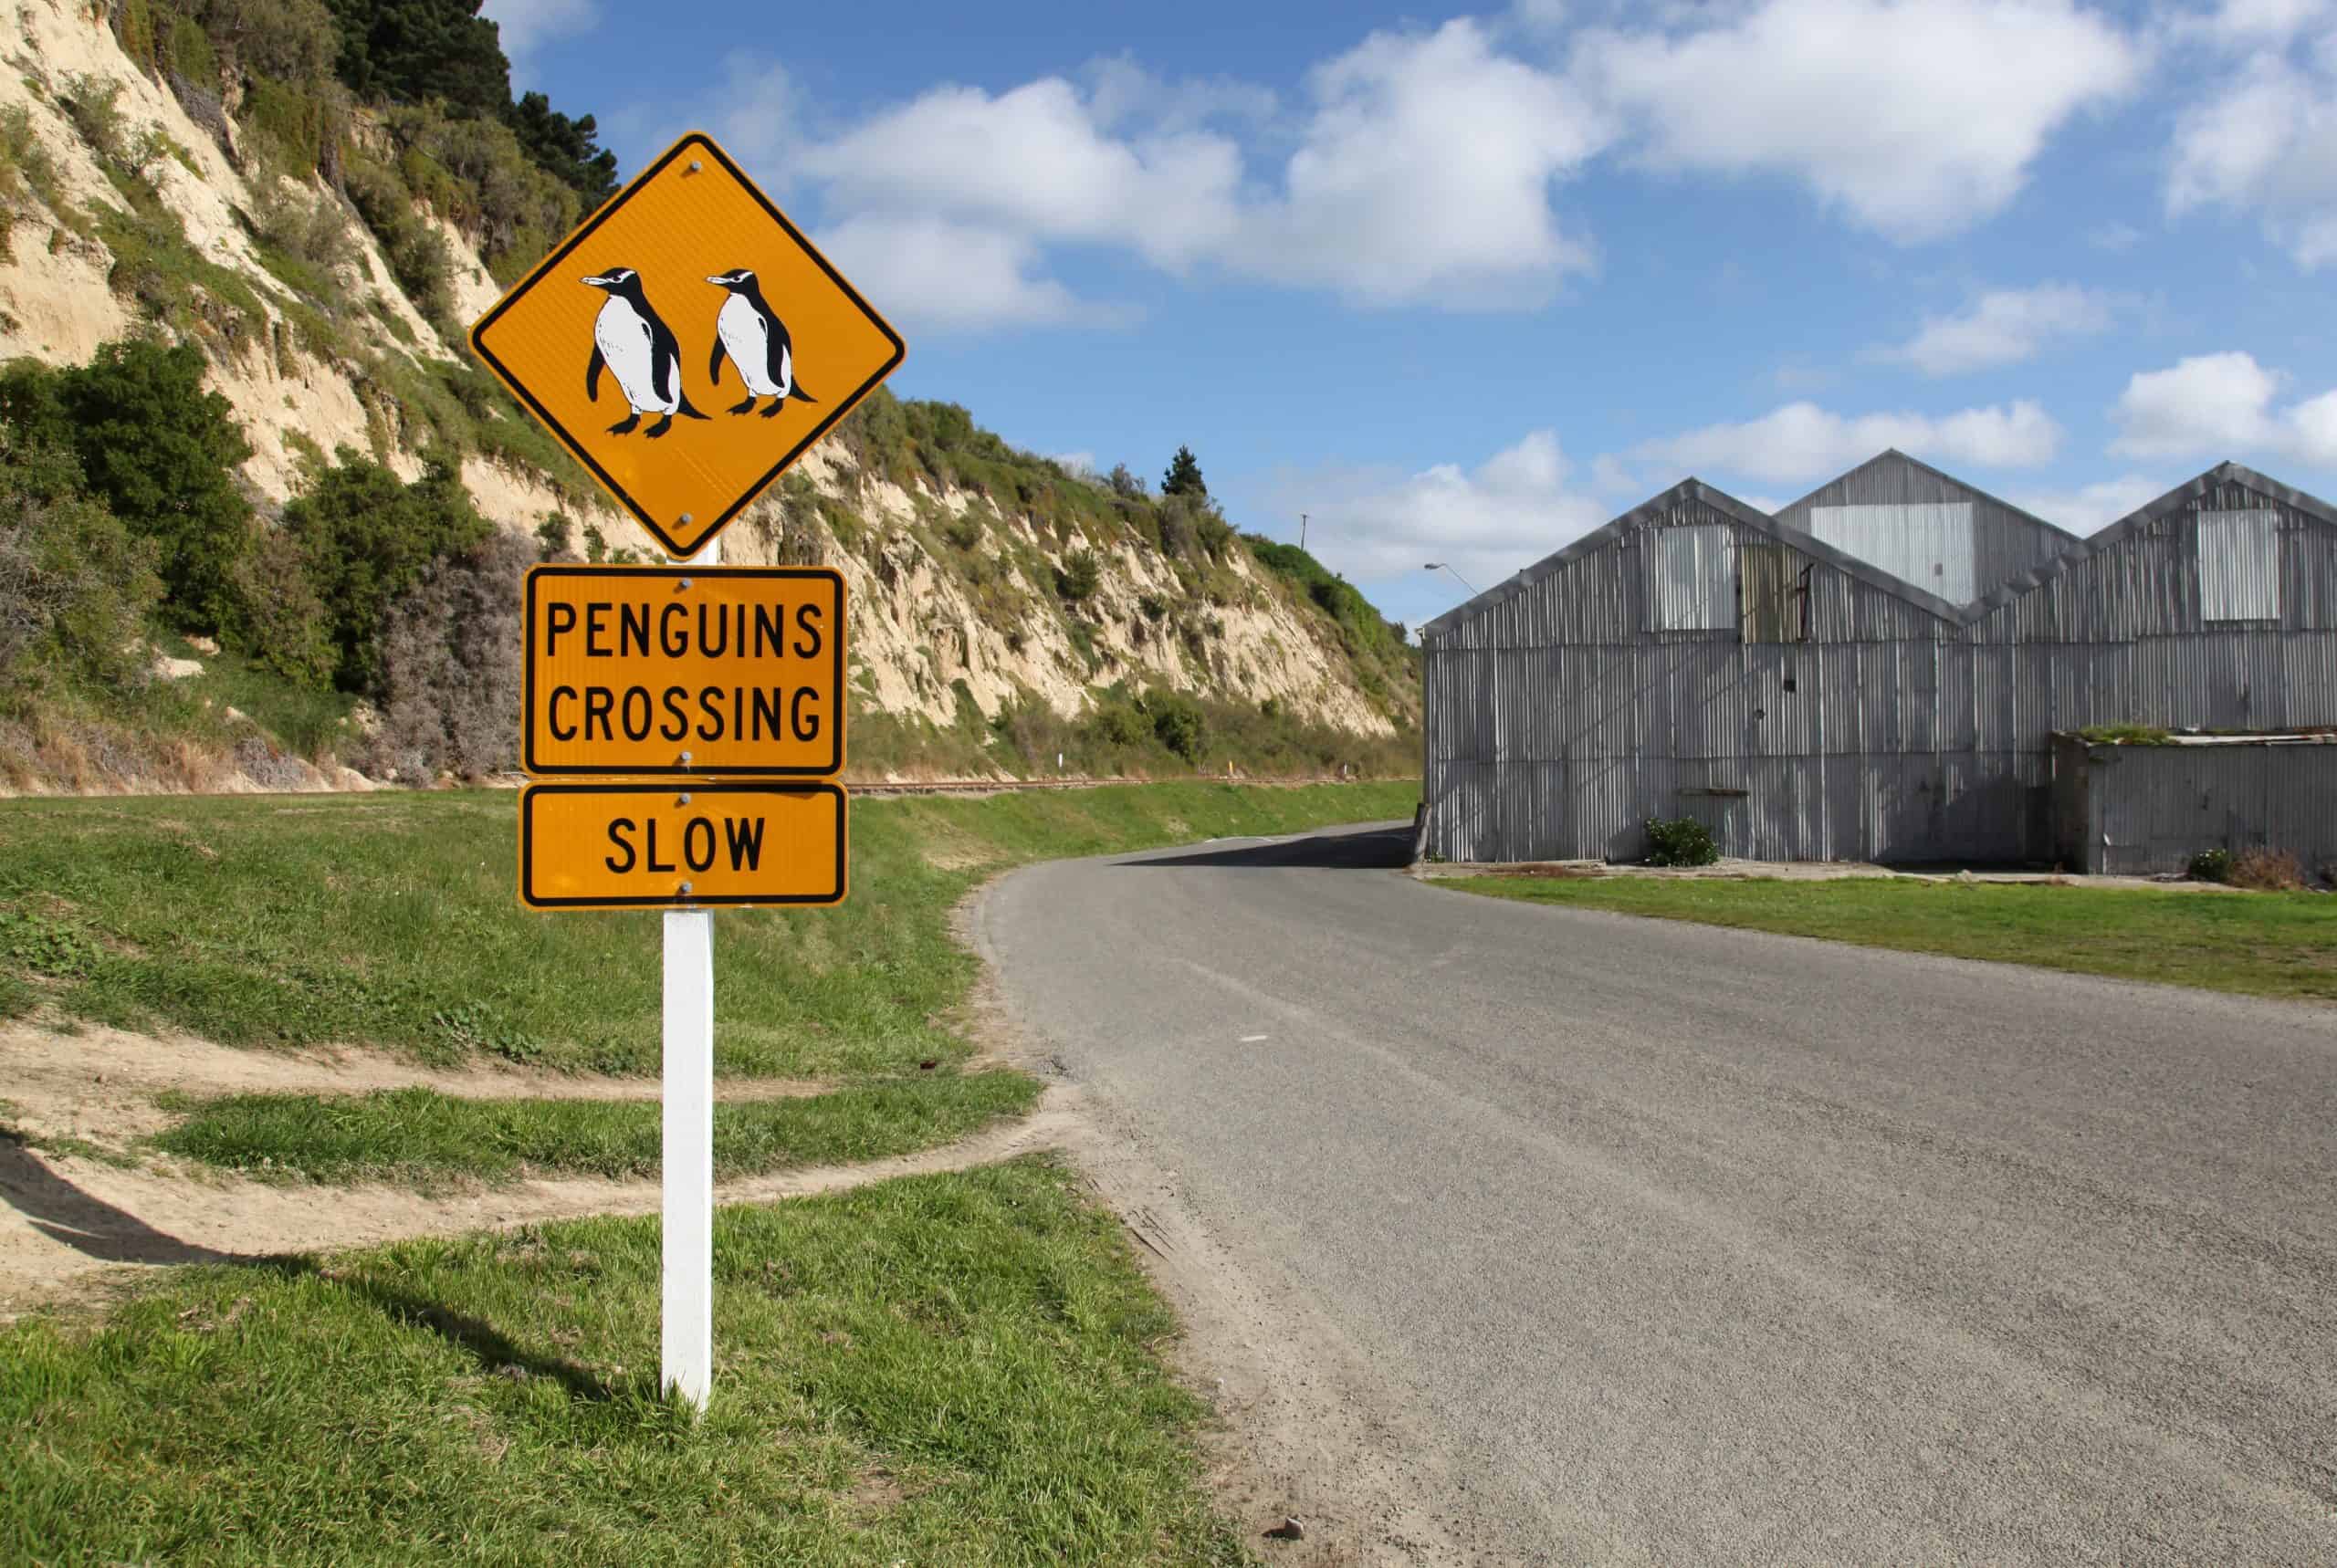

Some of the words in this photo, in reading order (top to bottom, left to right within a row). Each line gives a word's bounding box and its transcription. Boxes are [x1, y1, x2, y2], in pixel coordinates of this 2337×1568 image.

[547, 601, 823, 660] PENGUINS
[549, 685, 820, 742] CROSSING
[605, 817, 765, 874] SLOW
